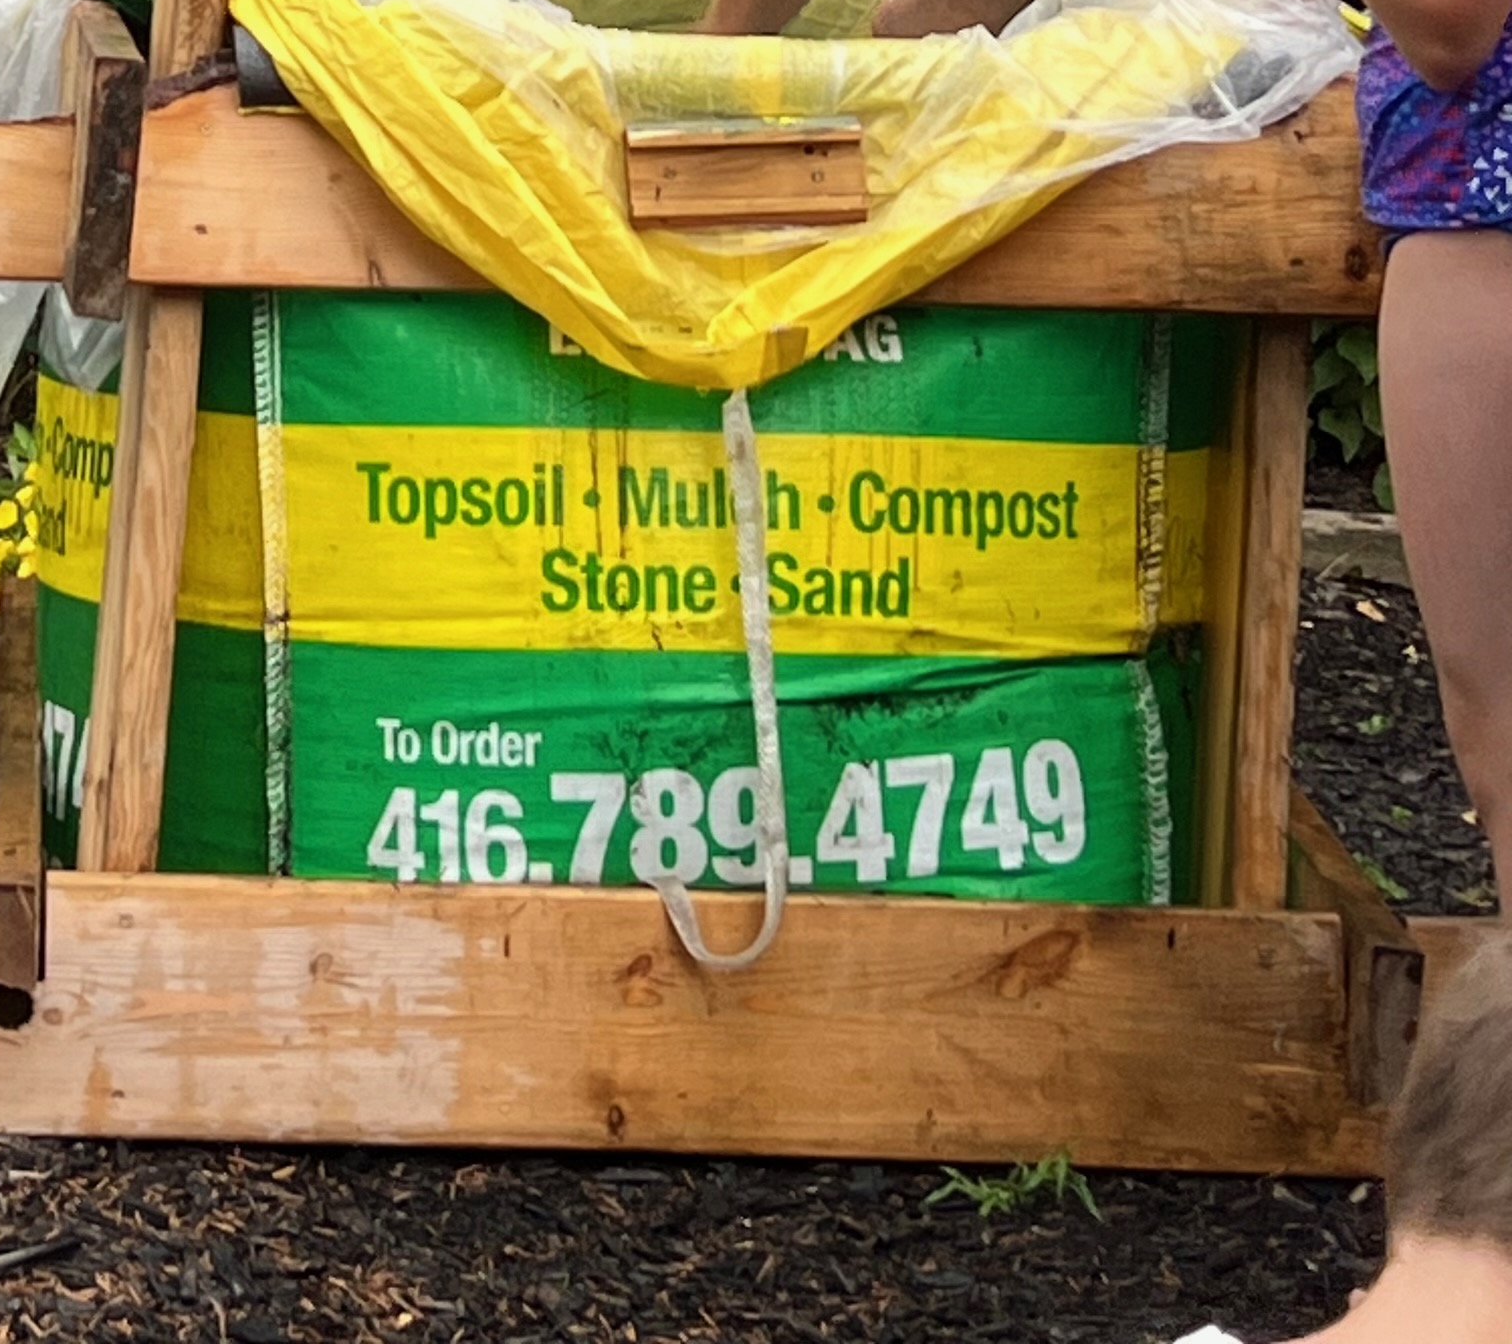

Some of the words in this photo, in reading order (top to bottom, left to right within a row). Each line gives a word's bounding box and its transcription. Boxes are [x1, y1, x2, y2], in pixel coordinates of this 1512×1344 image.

[356, 461, 564, 538] Topsoil
[618, 465, 801, 531] Mulh
[849, 469, 1078, 551] Compost
[541, 548, 717, 614] Stone
[766, 551, 911, 618] Sand
[376, 717, 423, 762] To
[431, 721, 542, 768] Order
[365, 737, 1087, 885] 416.789.4749
